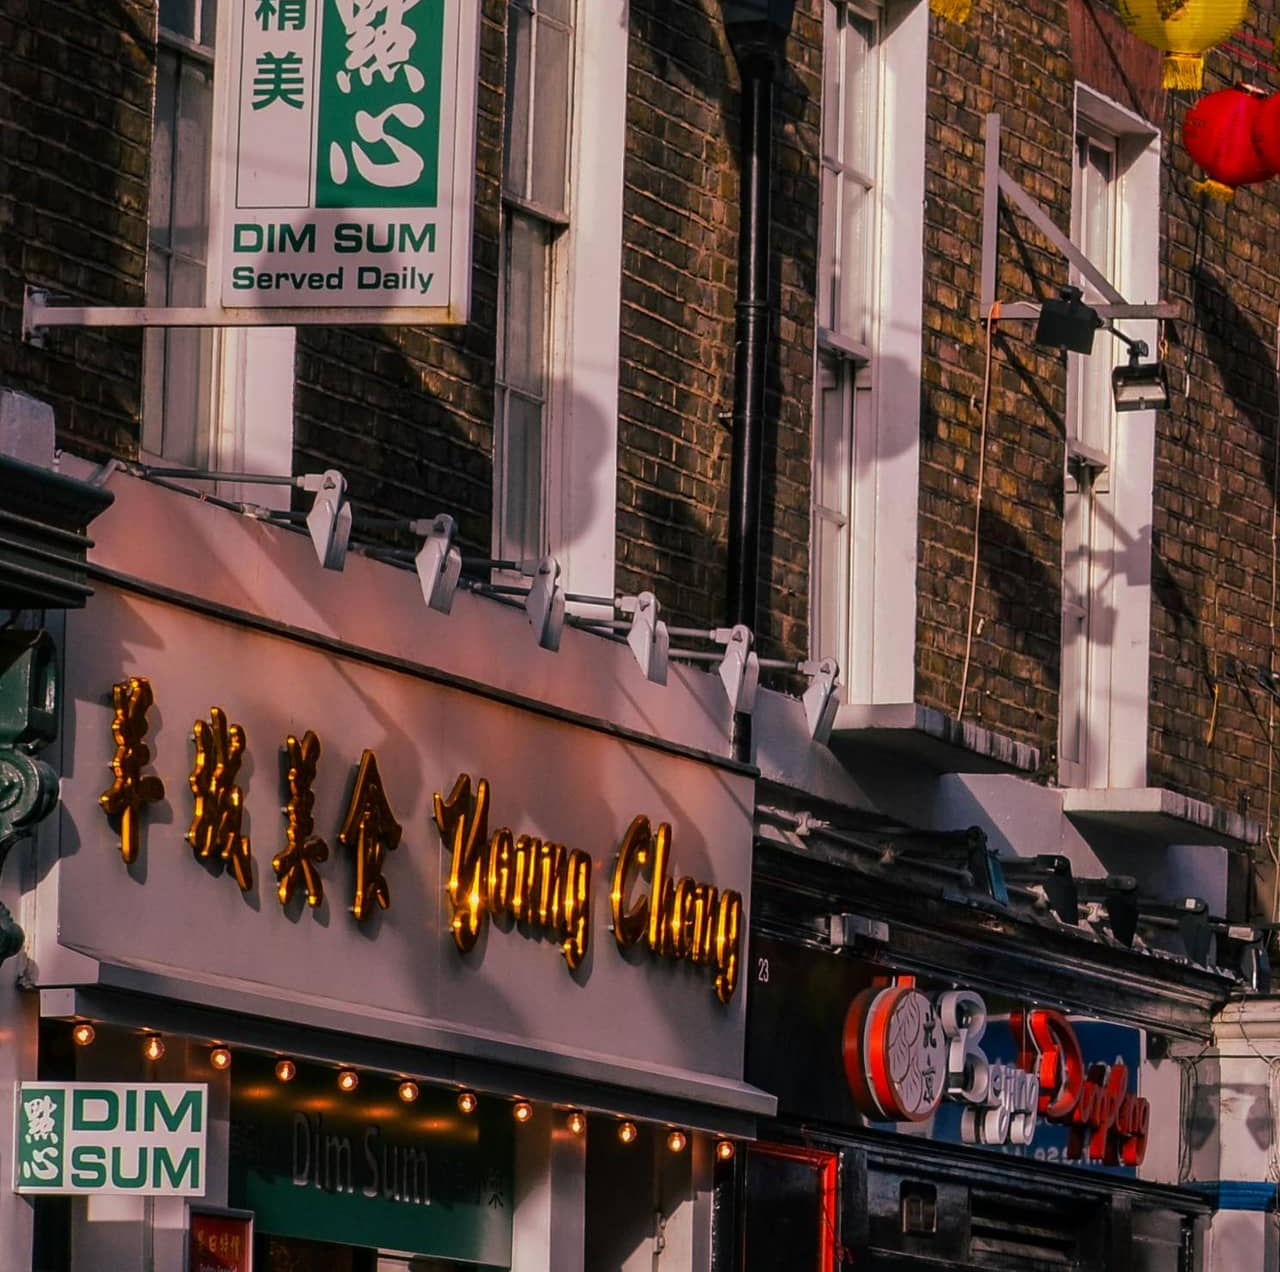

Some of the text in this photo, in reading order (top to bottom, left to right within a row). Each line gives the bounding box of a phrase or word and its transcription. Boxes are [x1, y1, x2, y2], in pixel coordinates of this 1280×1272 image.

[233, 223, 436, 253] DIM SUM
[232, 266, 434, 294] Served Daily
[758, 957, 770, 983] 23
[71, 1089, 201, 1132] DIM
[23, 1095, 58, 1180] 點心
[292, 1111, 431, 1206] Dim Sum
[71, 1146, 199, 1188] SUM
